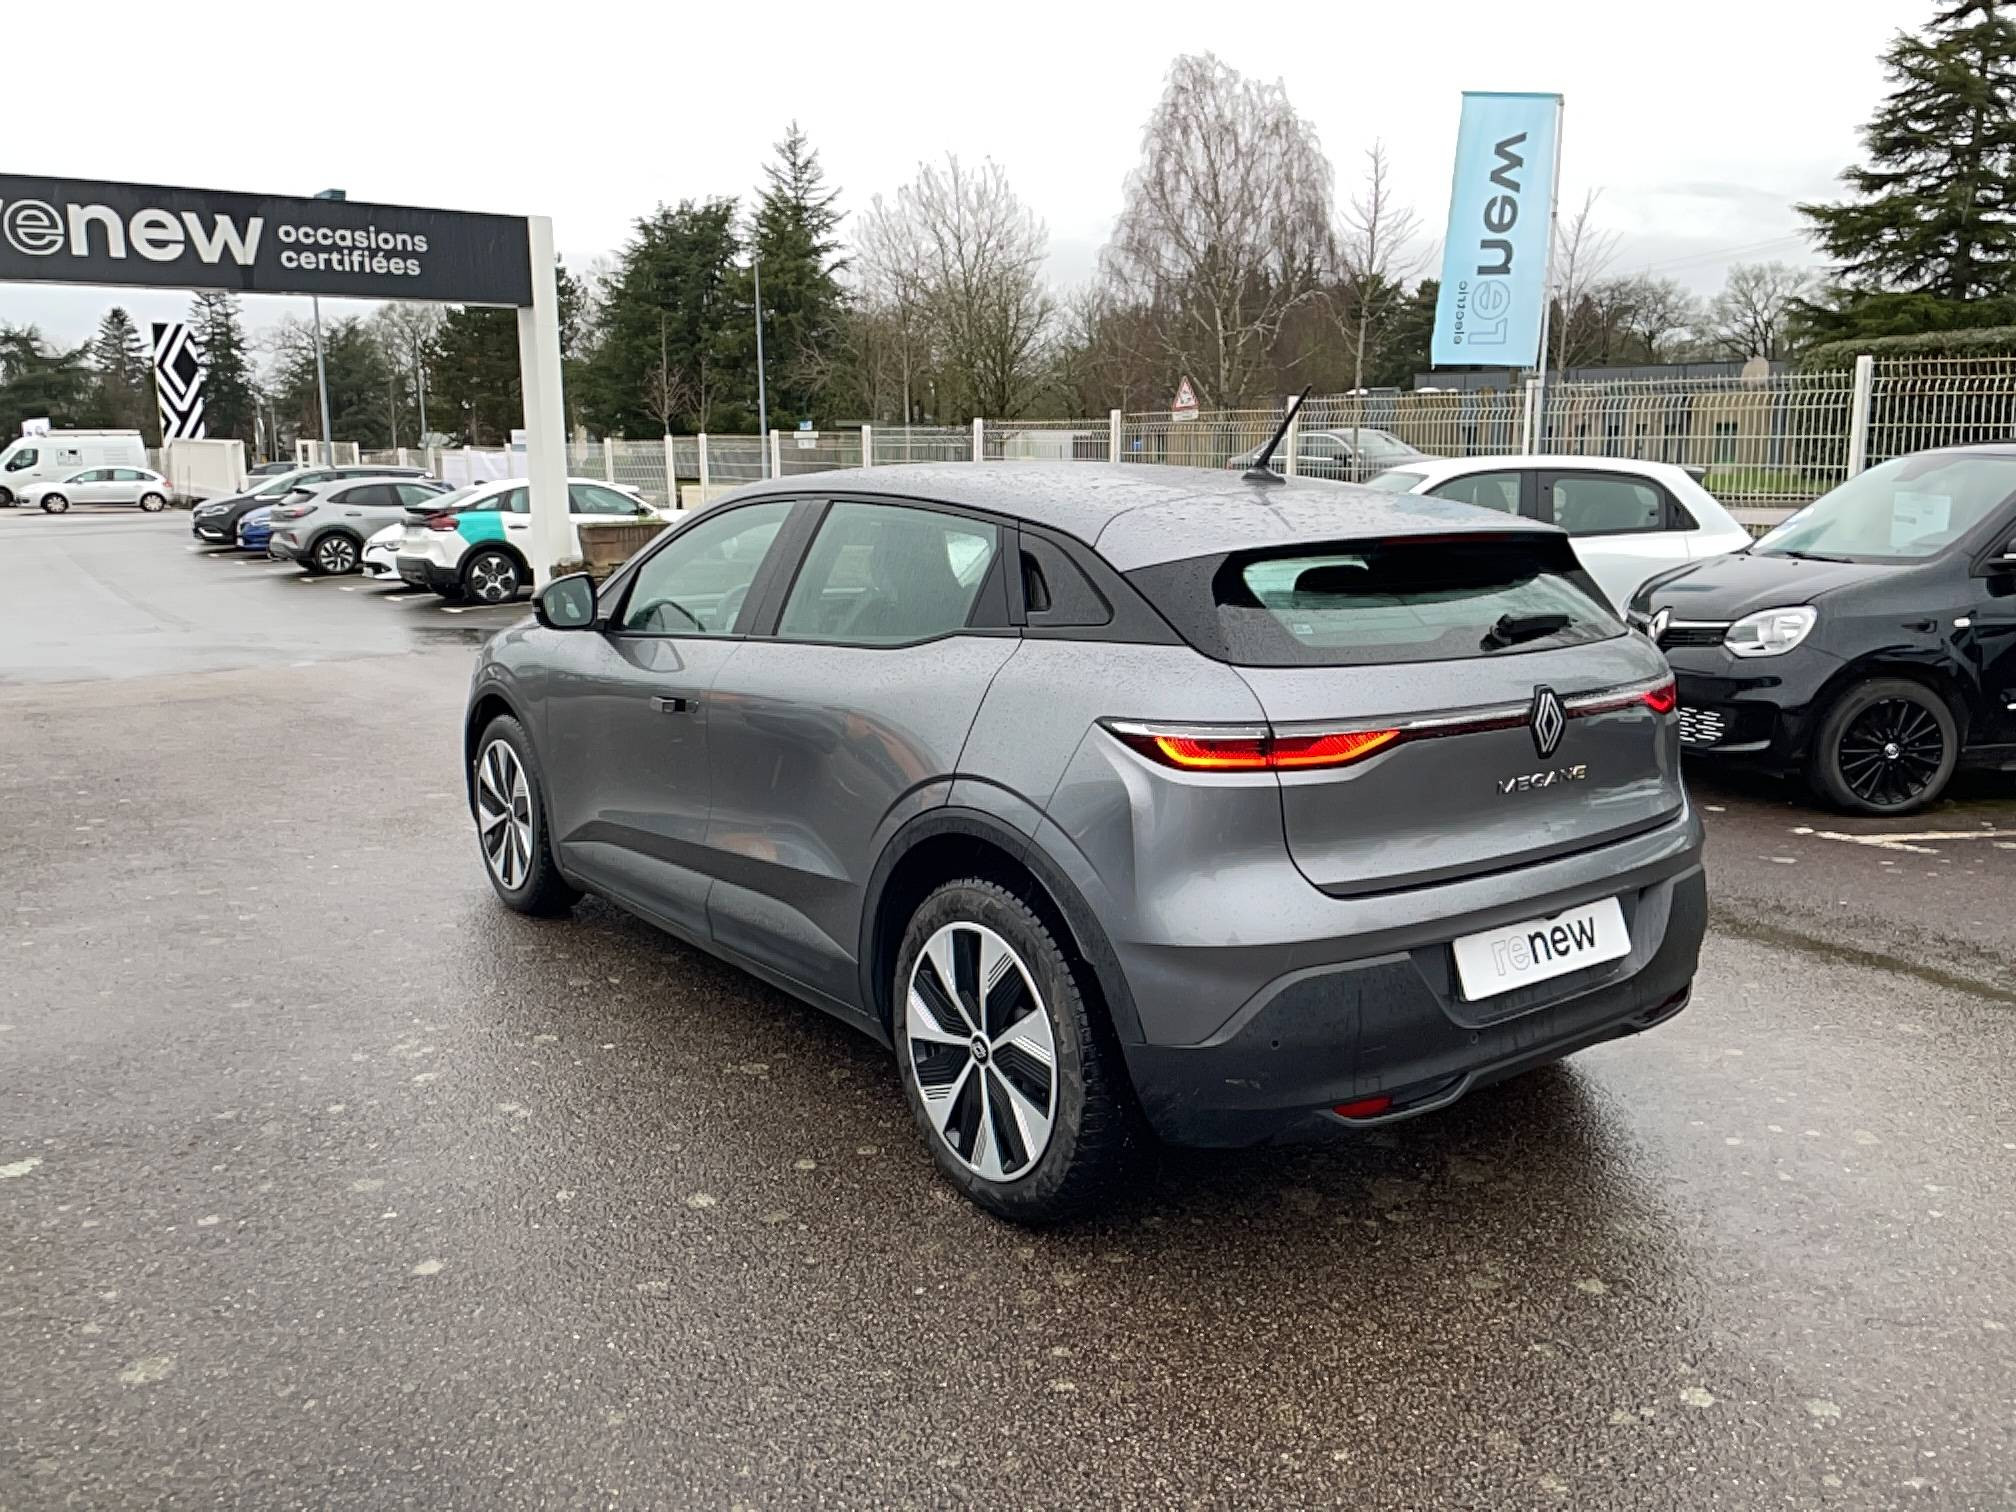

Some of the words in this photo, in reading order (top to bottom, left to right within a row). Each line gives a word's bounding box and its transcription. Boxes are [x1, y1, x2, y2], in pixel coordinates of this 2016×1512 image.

[0, 199, 264, 266] enew
[278, 225, 428, 252] occasions
[281, 249, 421, 276] certifiées
[1497, 764, 1588, 795] MEGANE
[1491, 916, 1596, 976] renew
